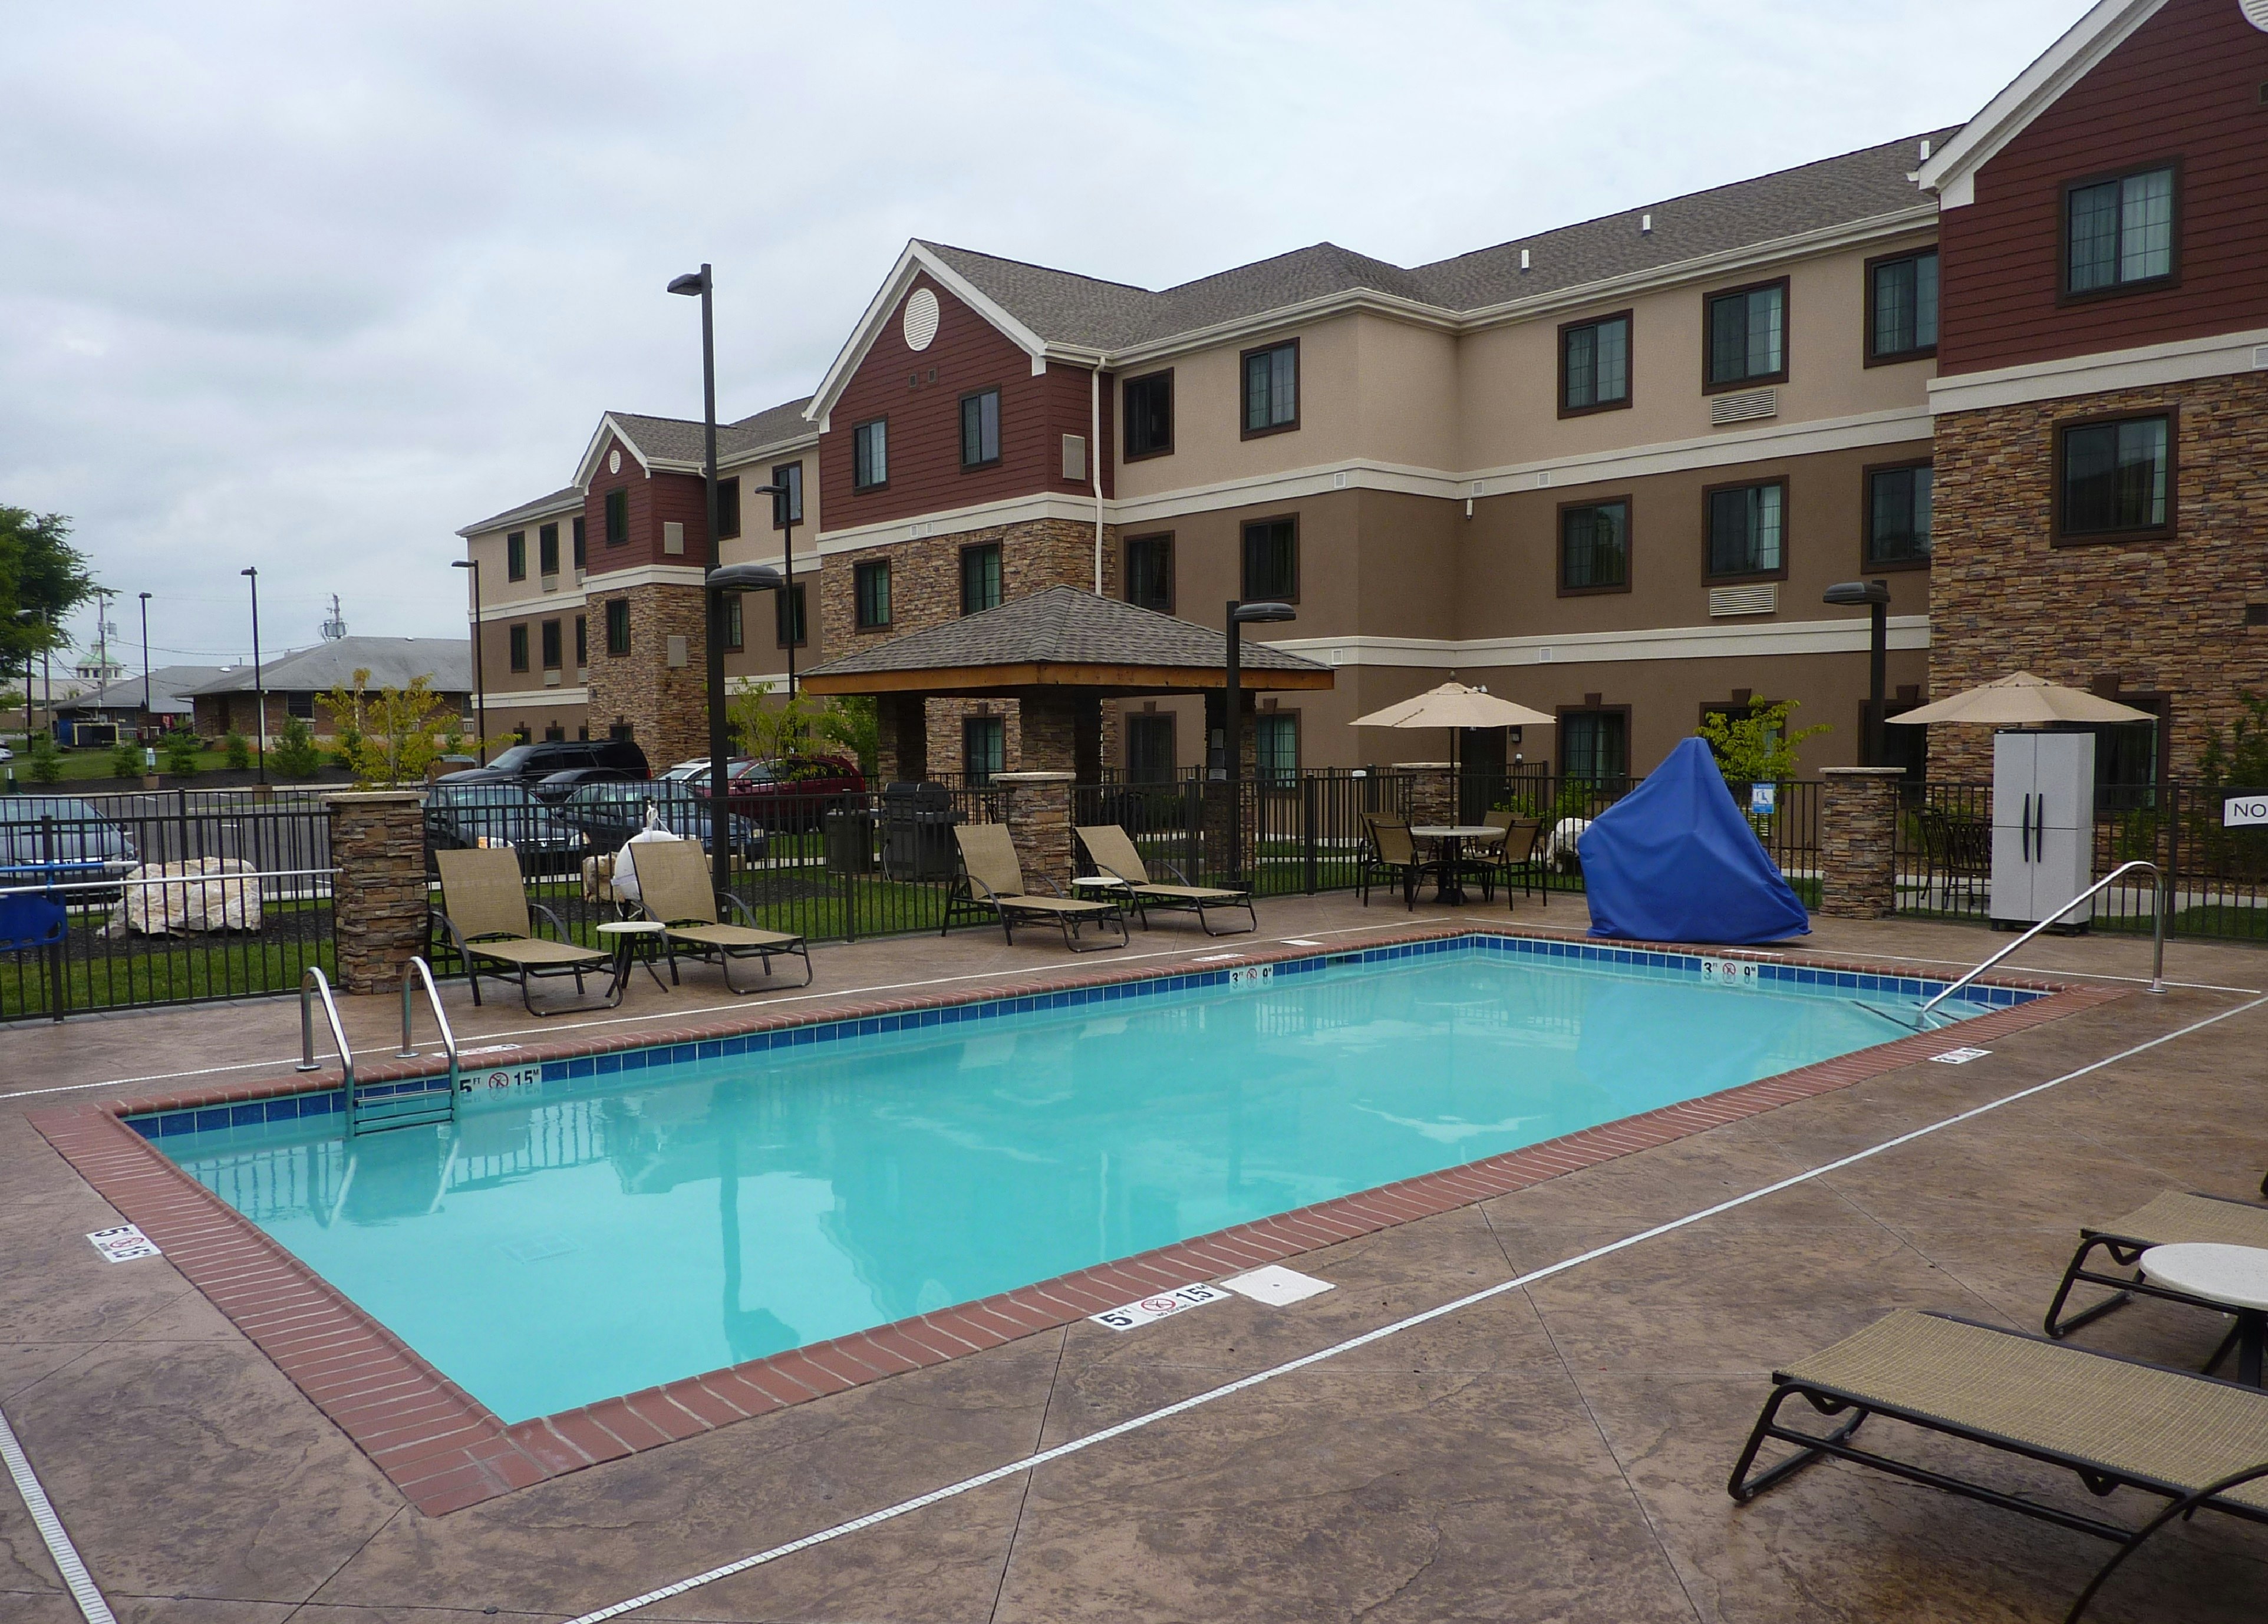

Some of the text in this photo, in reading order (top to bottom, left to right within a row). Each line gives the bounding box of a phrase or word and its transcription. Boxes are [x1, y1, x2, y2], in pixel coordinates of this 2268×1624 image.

[2234, 803, 2266, 817] NO
[1704, 962, 1712, 973] 3
[1232, 972, 1238, 982] 3
[459, 1079, 472, 1092] 5
[94, 1227, 129, 1237] 5
[1100, 1313, 1133, 1326] 5
[1175, 1288, 1214, 1302] 1.5
